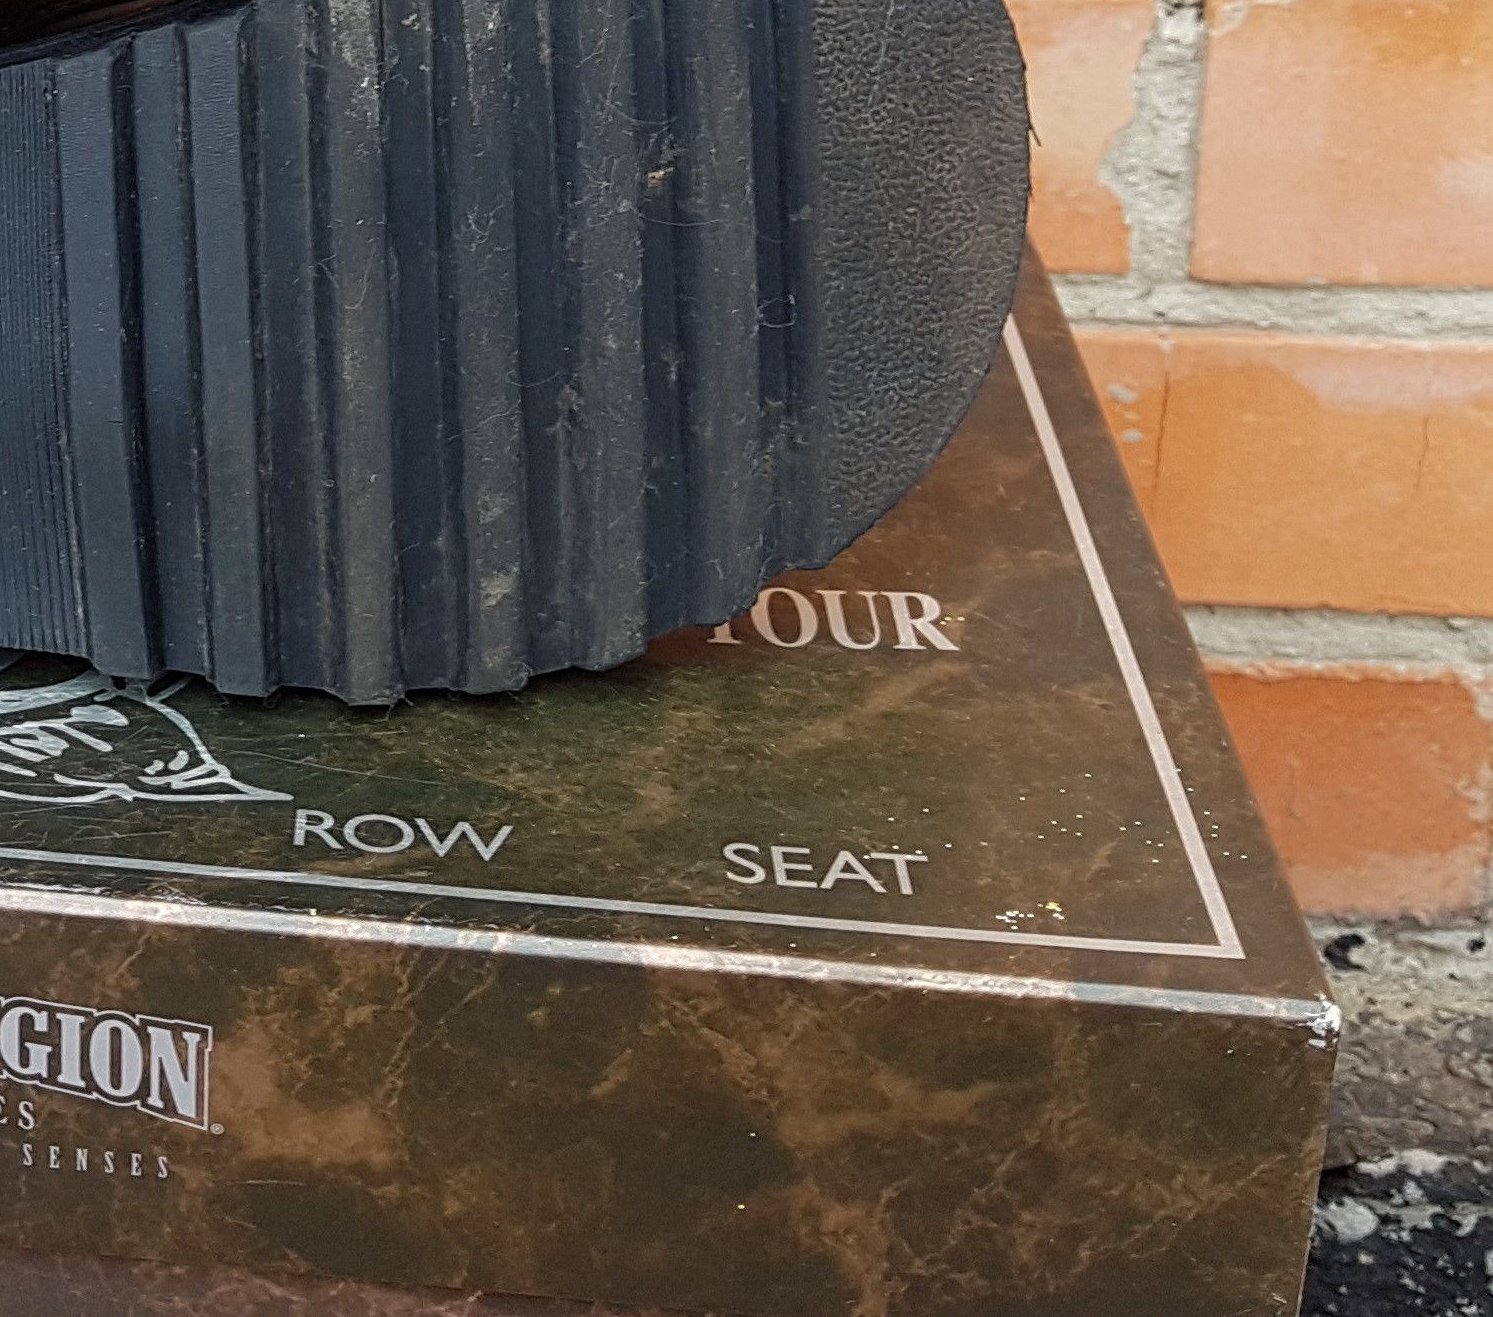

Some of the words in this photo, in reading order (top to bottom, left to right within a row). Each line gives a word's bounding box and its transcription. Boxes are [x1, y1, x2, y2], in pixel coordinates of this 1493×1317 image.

[292, 808, 514, 862] ROW
[722, 842, 929, 896] SEAT
[22, 1143, 169, 1179] SENSES
